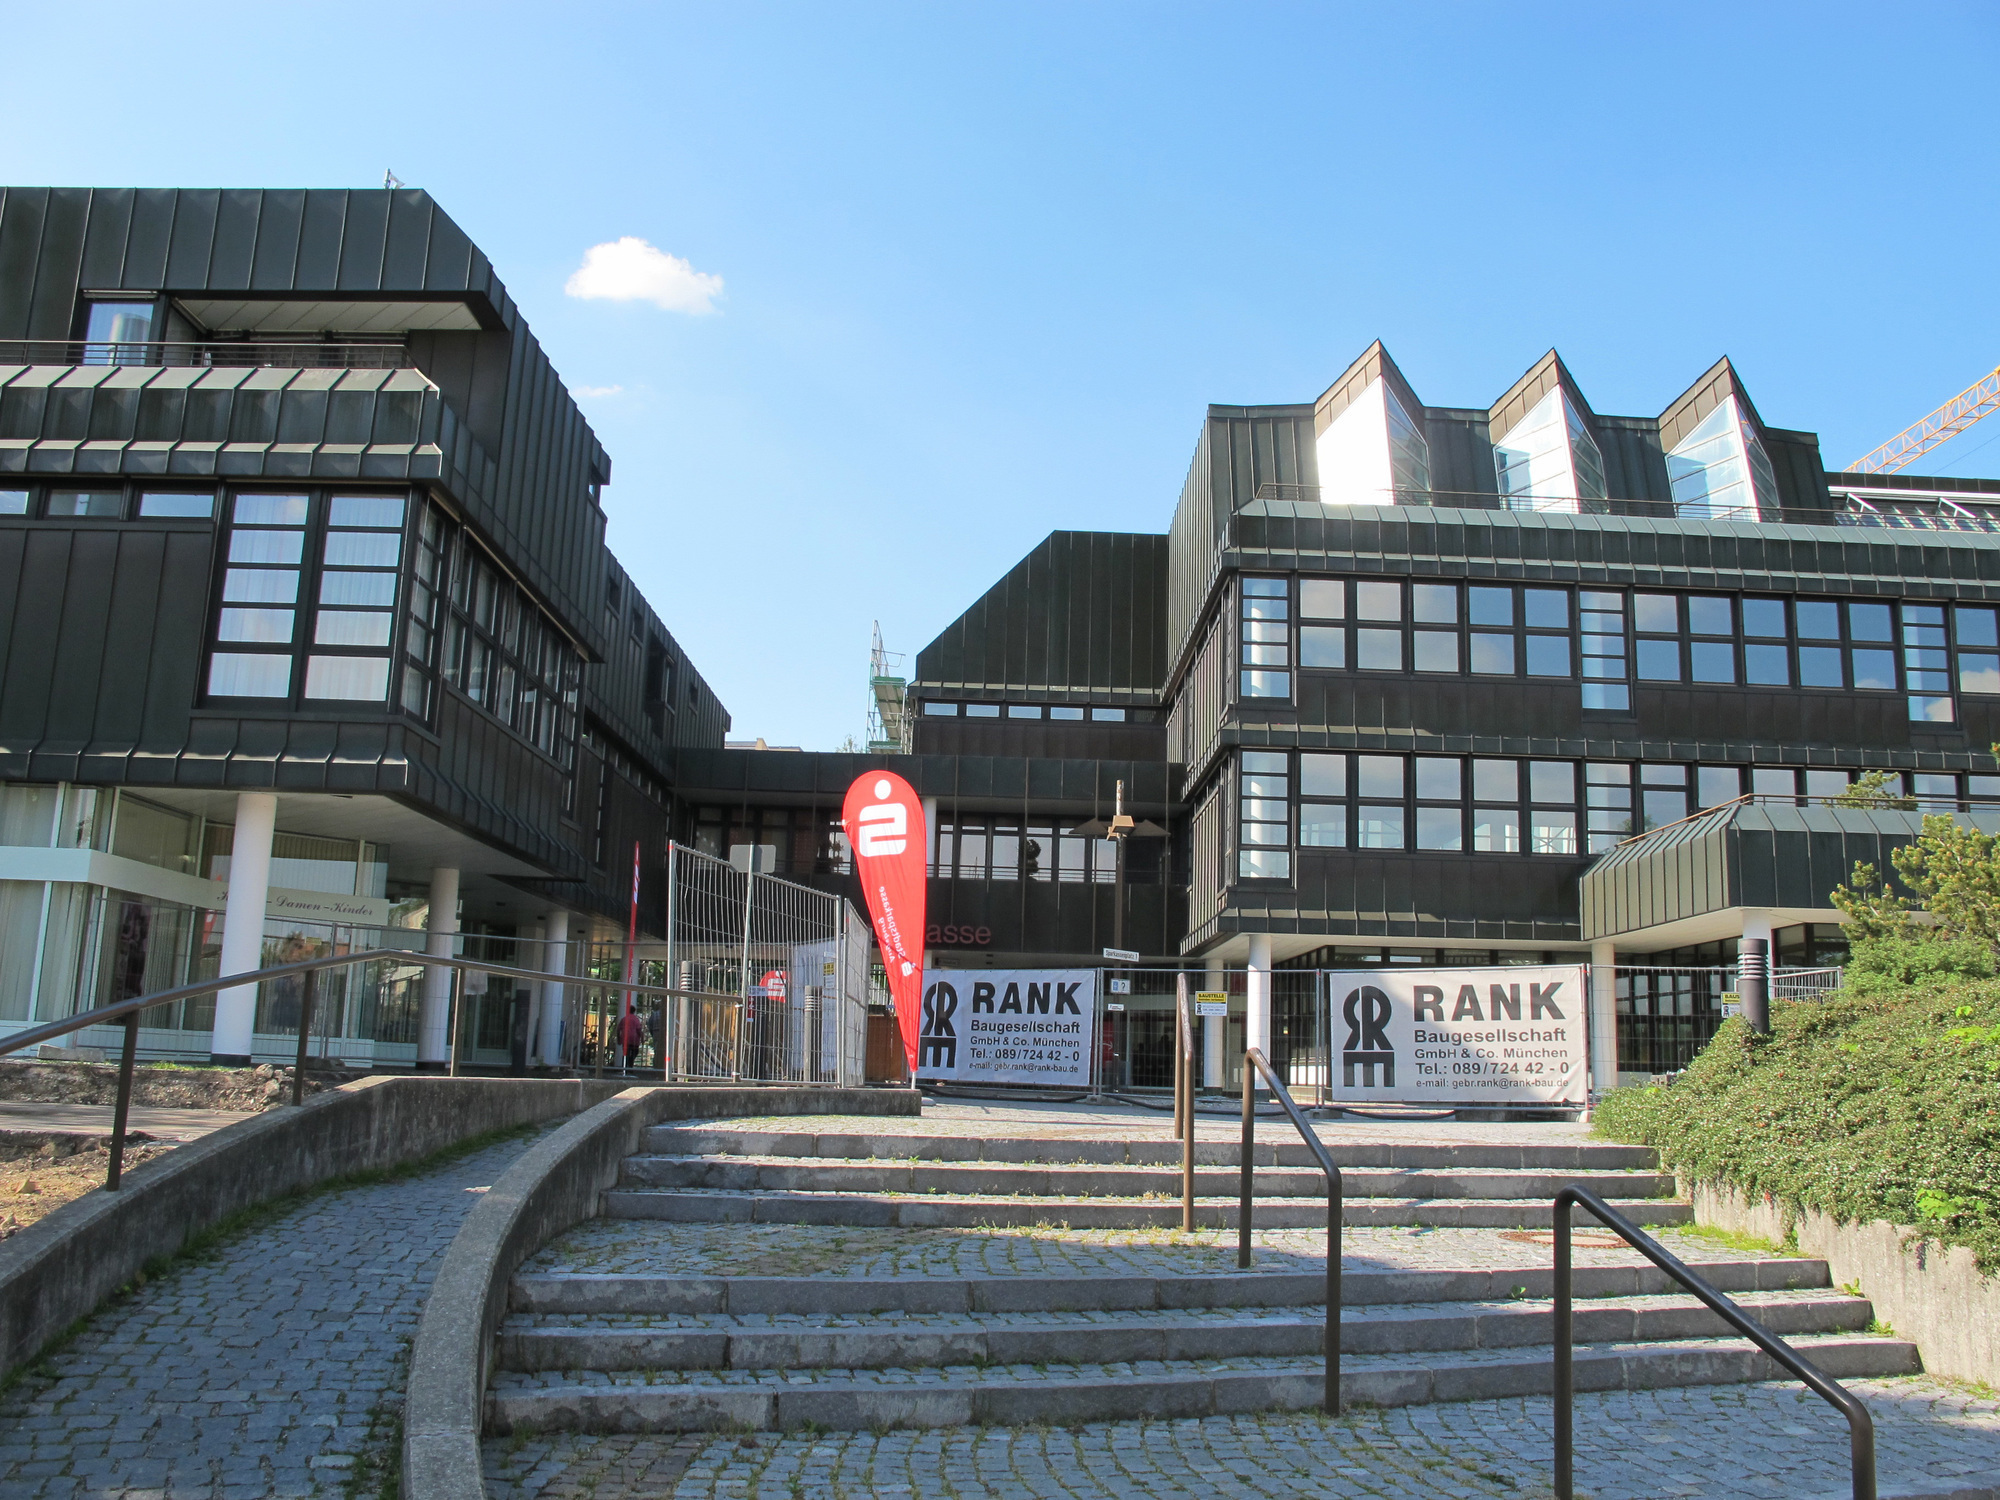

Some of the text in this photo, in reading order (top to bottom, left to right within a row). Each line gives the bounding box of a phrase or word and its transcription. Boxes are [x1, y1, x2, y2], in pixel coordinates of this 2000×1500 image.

[925, 924, 991, 945] asse
[972, 981, 1082, 1015] RANK
[1413, 981, 1566, 1022] RANK
[970, 1019, 1081, 1034] Baugesellschaft
[970, 1036, 1080, 1048] GmbH & Co. München
[1414, 1028, 1567, 1046] Baugesellschaft
[970, 1048, 992, 1059] Tel.:
[995, 1049, 1043, 1061] 089/724
[1047, 1050, 1061, 1061] 42
[1414, 1047, 1568, 1059] GmbH & Co. München
[969, 1062, 1079, 1073] e-mail: gebr.rank@rank-bau.de
[1415, 1062, 1447, 1075] Tel.:
[1452, 1062, 1519, 1075] 089/724
[1525, 1062, 1544, 1075] 42
[1416, 1078, 1569, 1090] e-mail: gebr.rank@rank-bau.de
